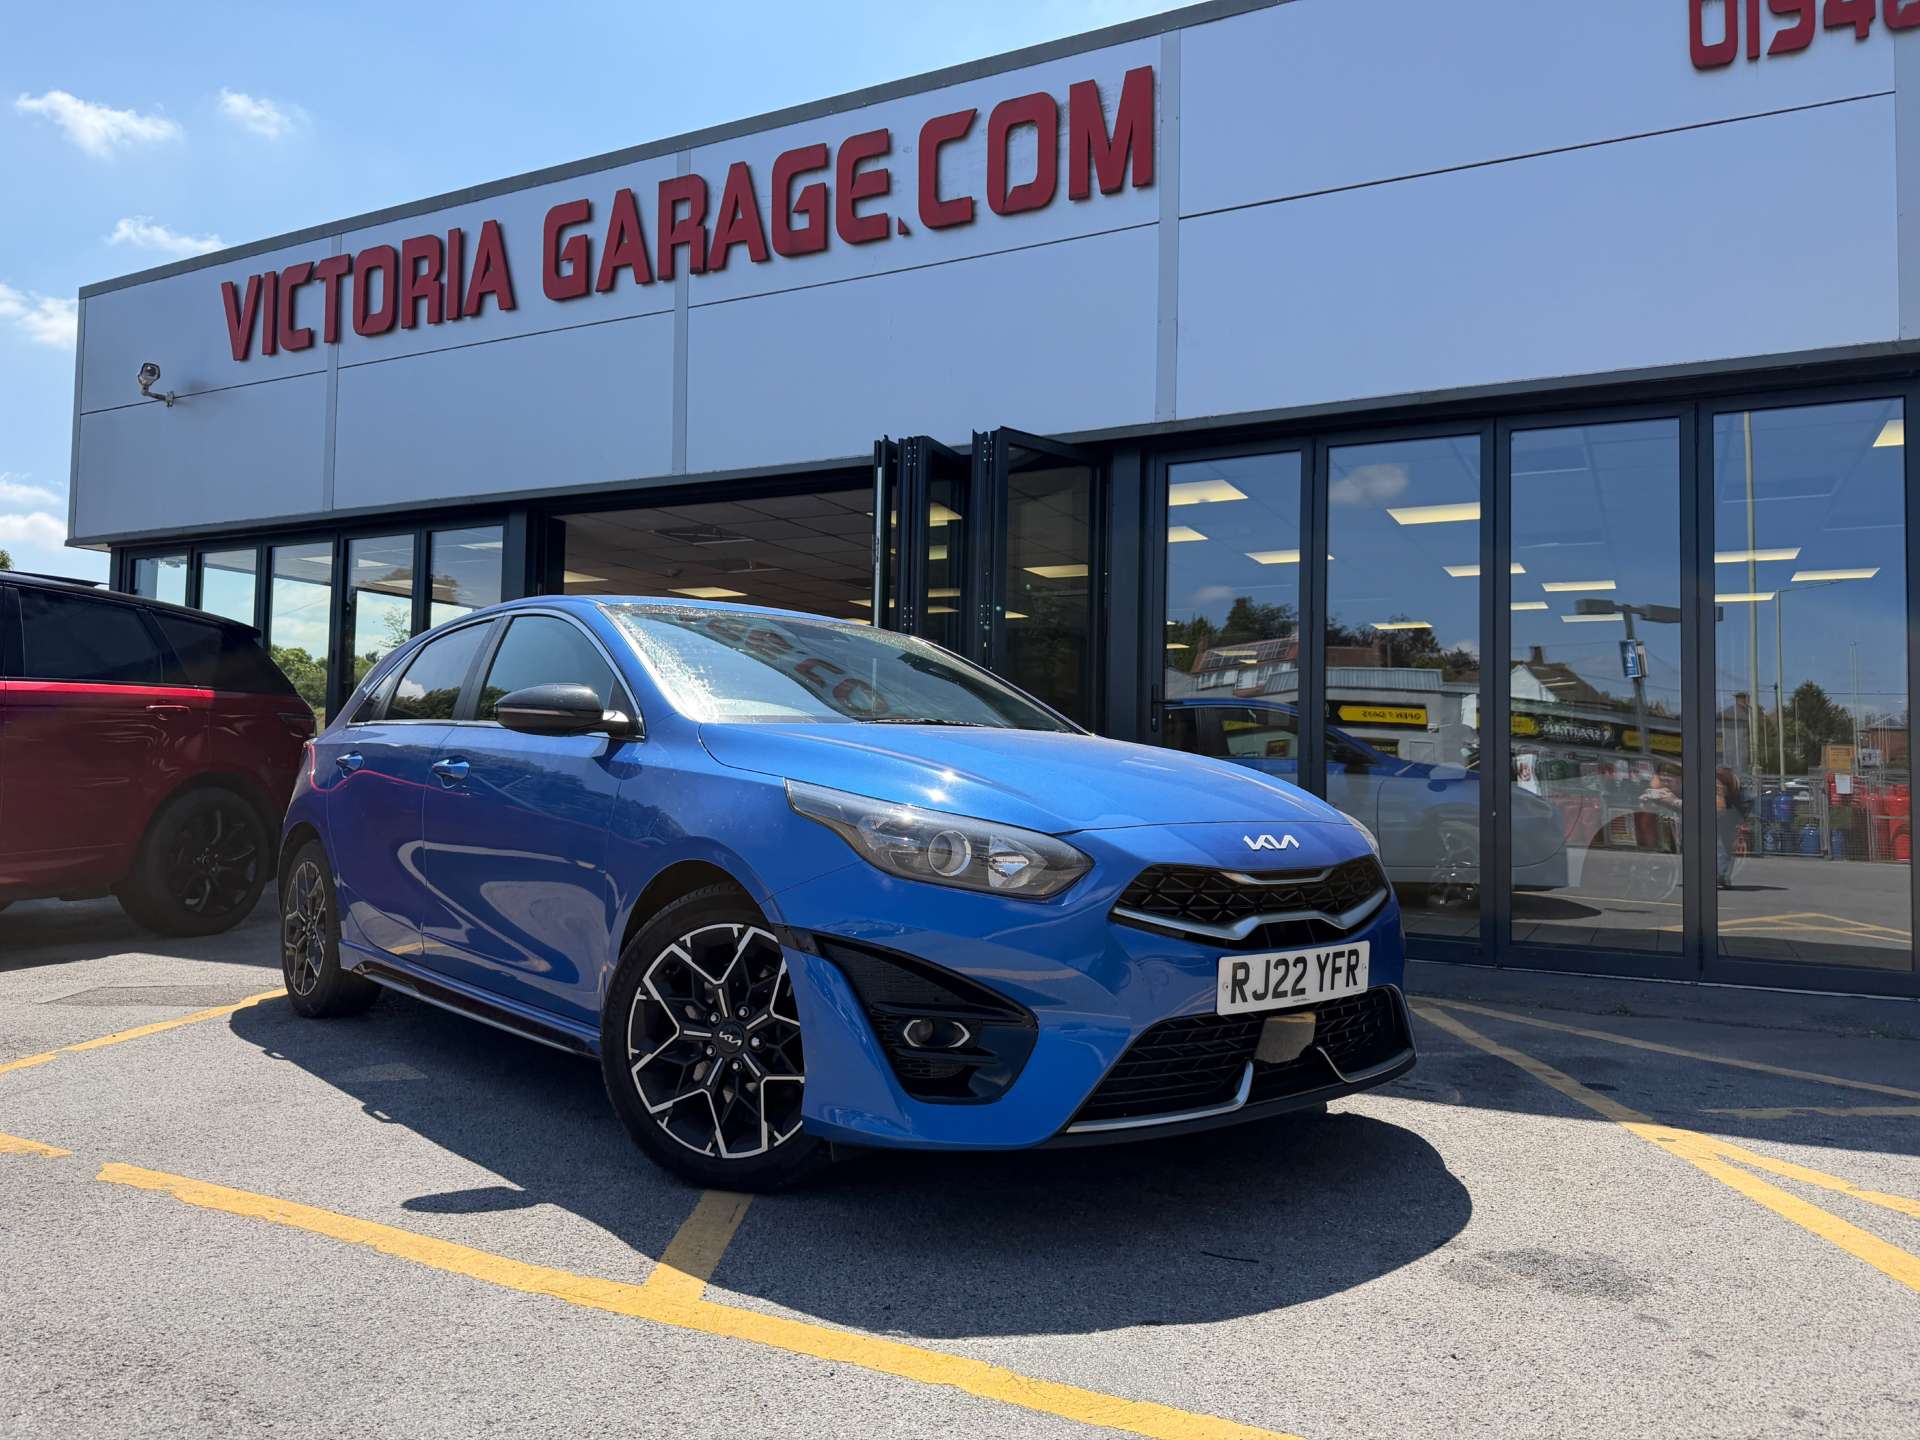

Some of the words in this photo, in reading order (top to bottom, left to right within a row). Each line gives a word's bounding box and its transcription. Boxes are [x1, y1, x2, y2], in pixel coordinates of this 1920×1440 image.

[221, 220, 514, 361] VICTORIA
[542, 66, 1154, 300] GARAGE.COM
[1243, 835, 1300, 850] KIA
[1230, 957, 1308, 1004] RJ22
[1316, 949, 1360, 993] YFR
